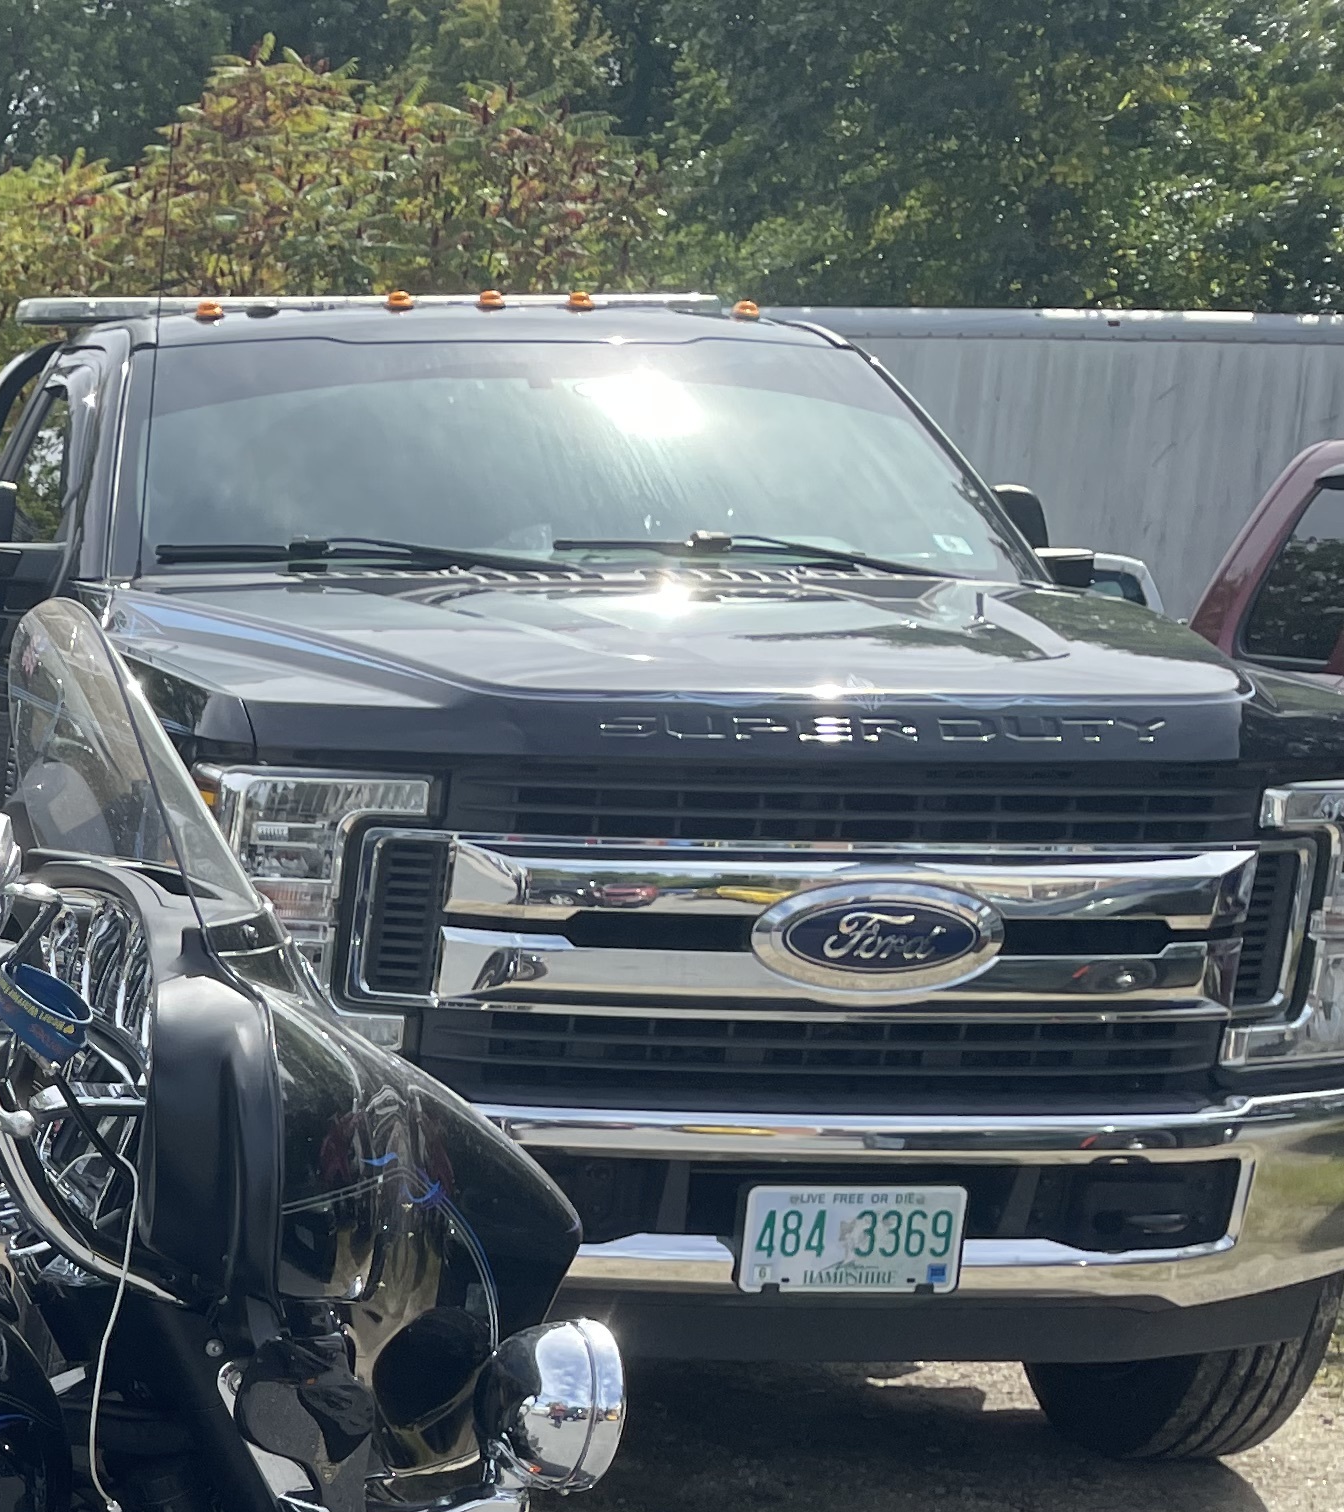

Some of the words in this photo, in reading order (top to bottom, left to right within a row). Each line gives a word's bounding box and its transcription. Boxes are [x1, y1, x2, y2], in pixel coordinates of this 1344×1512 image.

[599, 715, 919, 743] SUPER
[937, 716, 1166, 743] DUTY
[822, 910, 948, 960] Ford
[799, 1193, 826, 1205] LIVE
[832, 1193, 865, 1205] FREE
[870, 1193, 889, 1205] OR
[895, 1193, 915, 1205] DIE
[755, 1209, 828, 1258] 484
[853, 1209, 954, 1258] 3369
